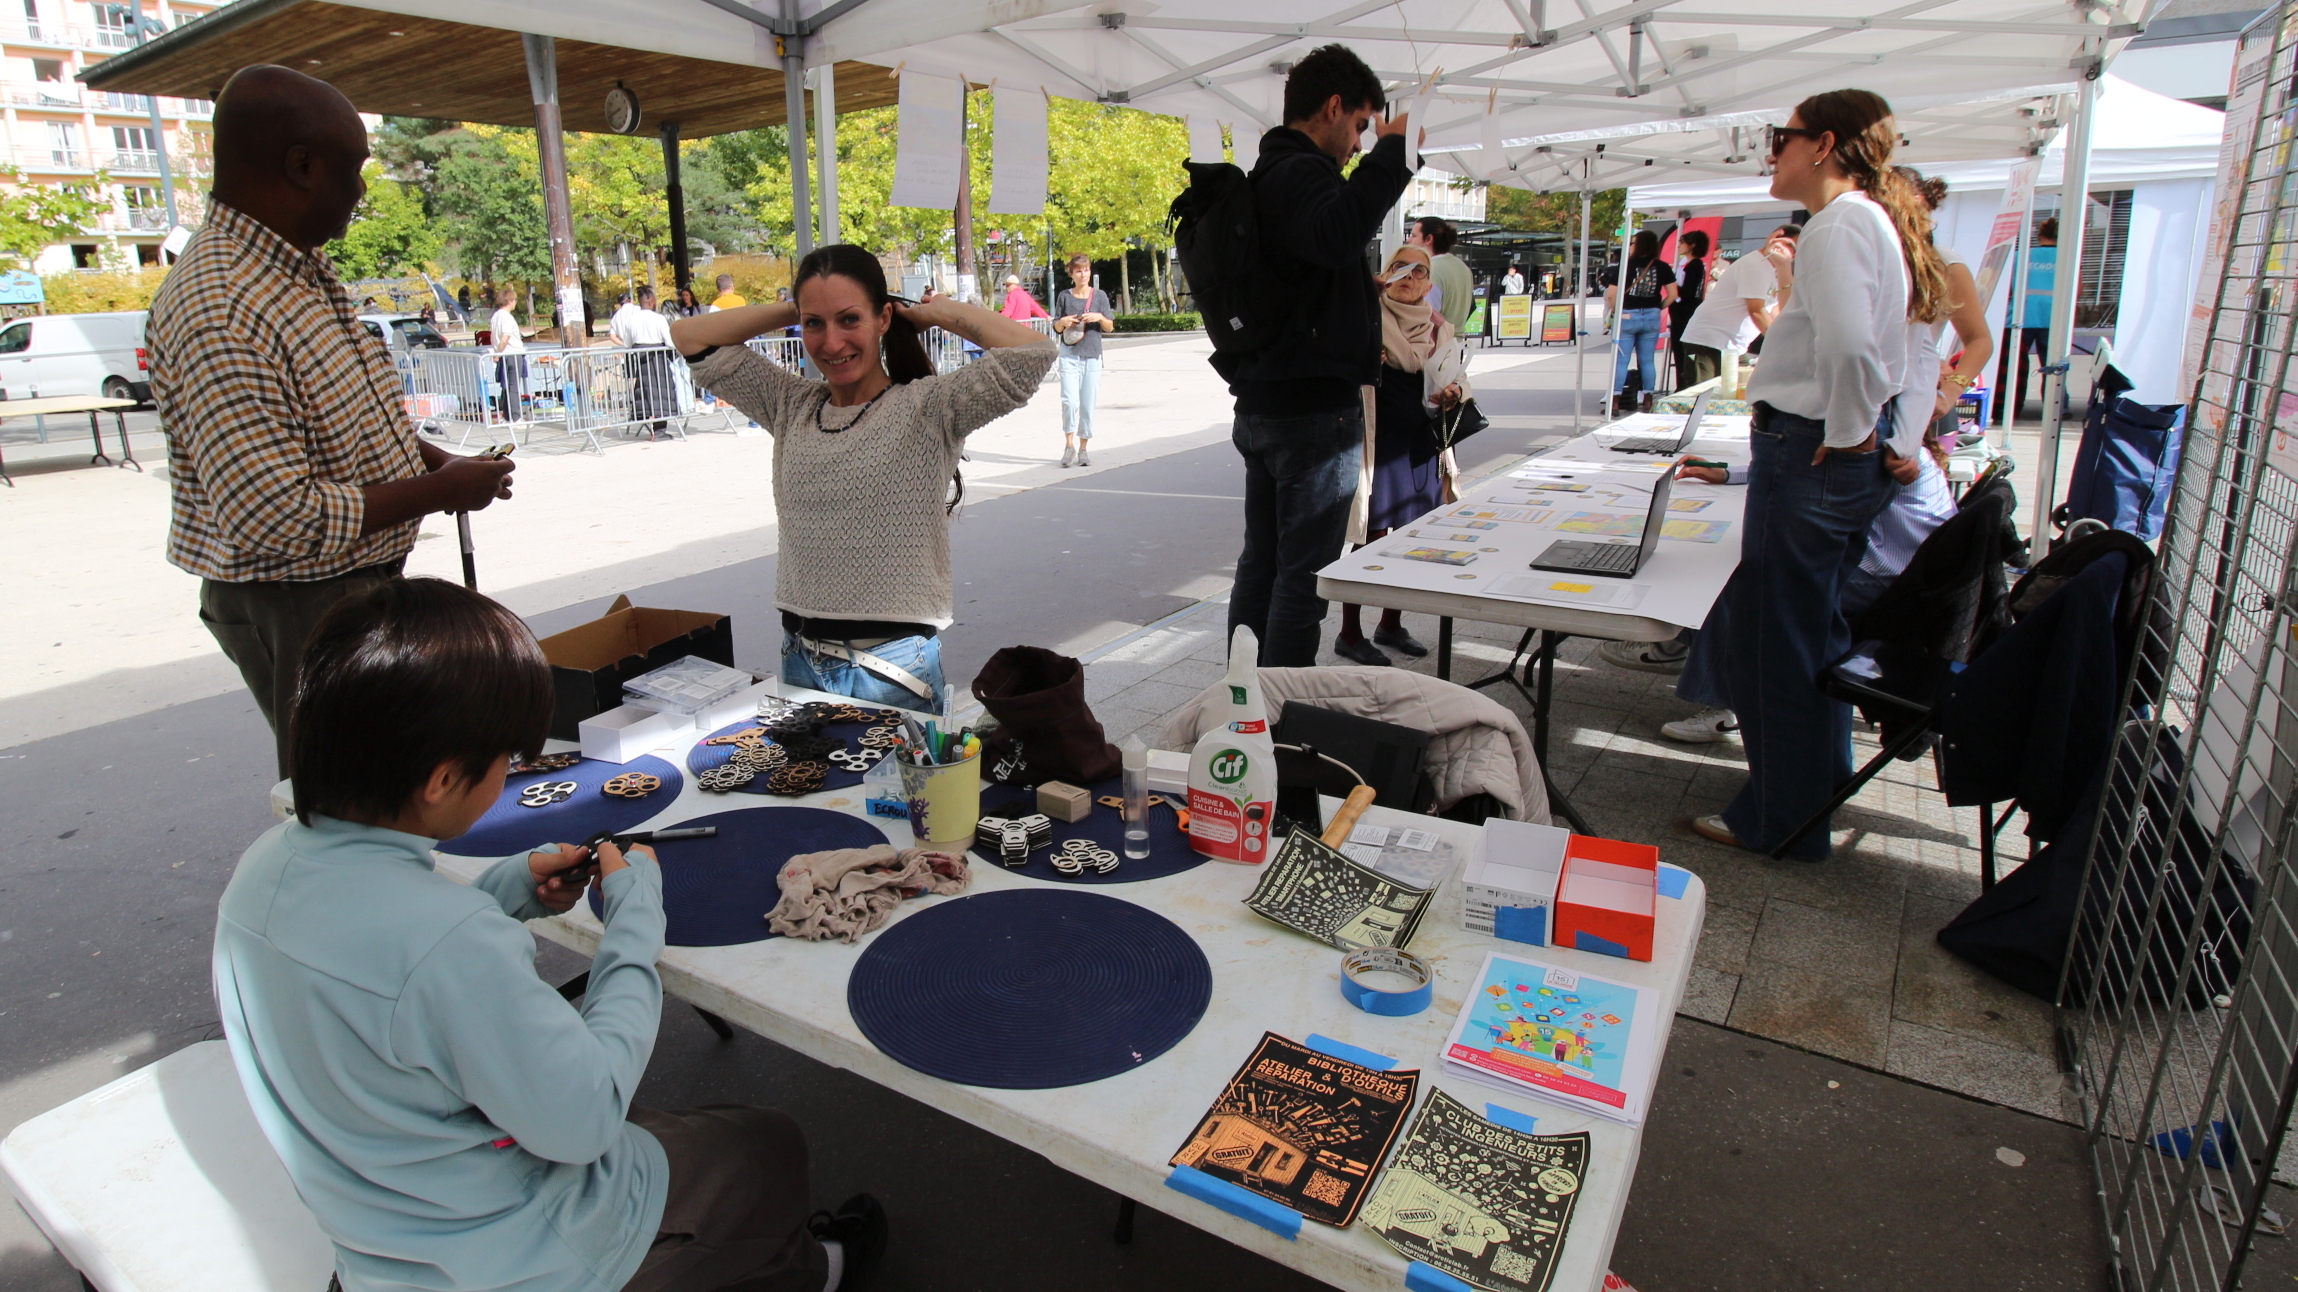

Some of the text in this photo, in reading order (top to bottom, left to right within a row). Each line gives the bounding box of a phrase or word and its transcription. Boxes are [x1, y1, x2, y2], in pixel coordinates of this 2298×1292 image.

[1212, 754, 1244, 778] Cif
[1208, 782, 1247, 794] Cleanboost
[1193, 795, 1218, 806] CUISINE
[1193, 802, 1212, 812] SALLE
[1260, 885, 1277, 906] ATELIER
[1274, 846, 1302, 887] REPARATION
[1275, 862, 1304, 902] SMARTPHONE
[1281, 1041, 1290, 1050] DU
[1291, 1044, 1311, 1055] MARDI
[1322, 1054, 1354, 1068] VENDREDI
[1256, 1065, 1336, 1096] REPARATION
[1260, 1058, 1312, 1080] ATELIER
[1308, 1057, 1408, 1092] BIBLIOTHEQUE
[1322, 1073, 1332, 1082] &
[1341, 1074, 1404, 1100] D'OUTILS
[1446, 1110, 1566, 1156] CLUB DES PETITS
[1459, 1107, 1472, 1117] LES
[1472, 1114, 1501, 1129] SAMEDIS
[1514, 1130, 1532, 1140] 14H30
[1215, 1149, 1251, 1159] GRATUIT
[1461, 1127, 1547, 1162] INGENIEURS
[1364, 1210, 1378, 1219] RT
[1369, 1207, 1382, 1215] VE
[1373, 1200, 1387, 1210] OU
[1400, 1210, 1433, 1221] GRATUIT
[1389, 1238, 1429, 1262] INSCRIPTION
